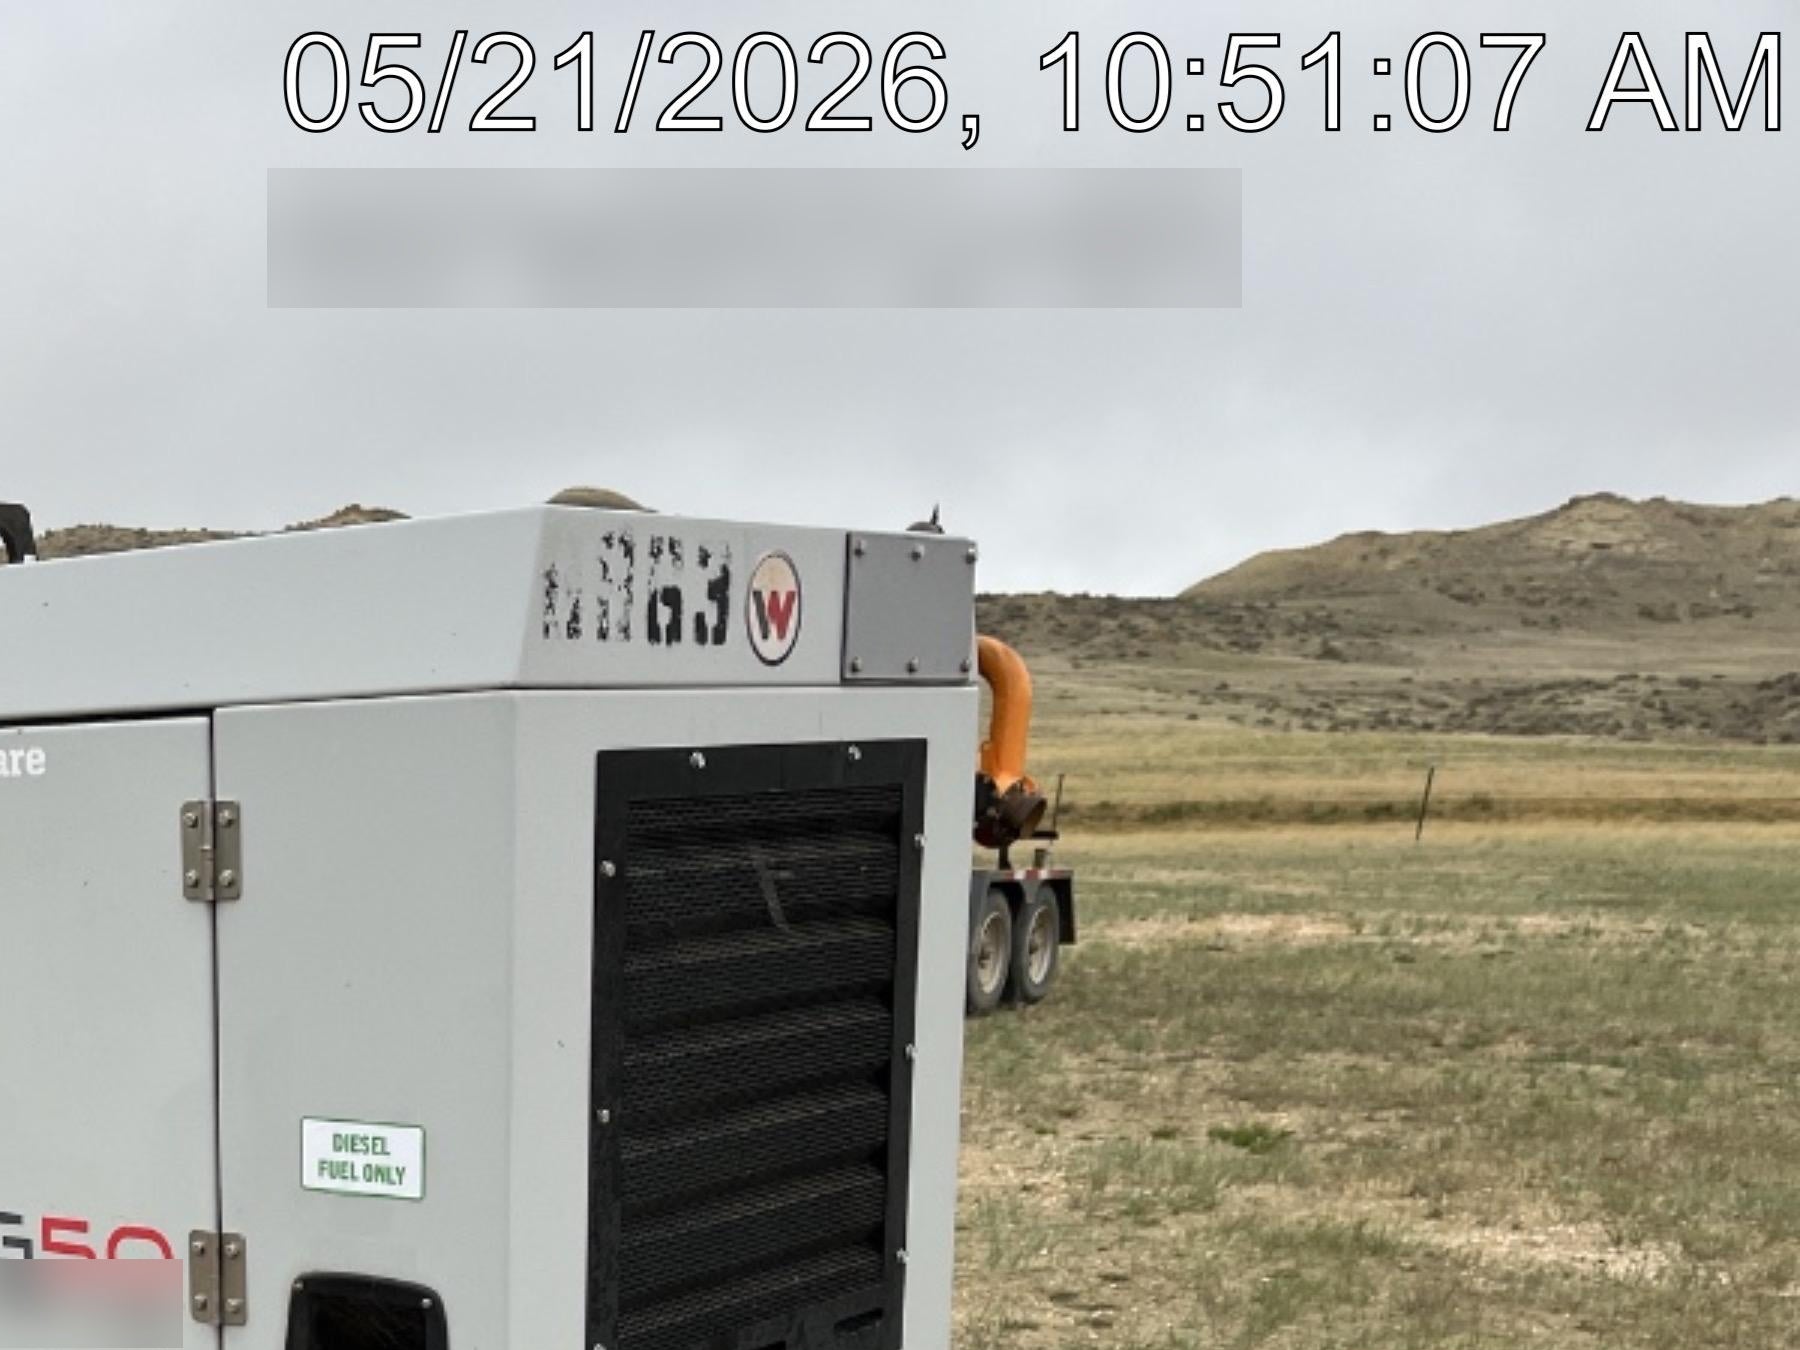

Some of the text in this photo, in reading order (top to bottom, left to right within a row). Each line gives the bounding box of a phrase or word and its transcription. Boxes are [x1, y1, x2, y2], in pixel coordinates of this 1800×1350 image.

[332, 1133, 391, 1156] DIESEL
[317, 1159, 406, 1186] FUEL ONLY
